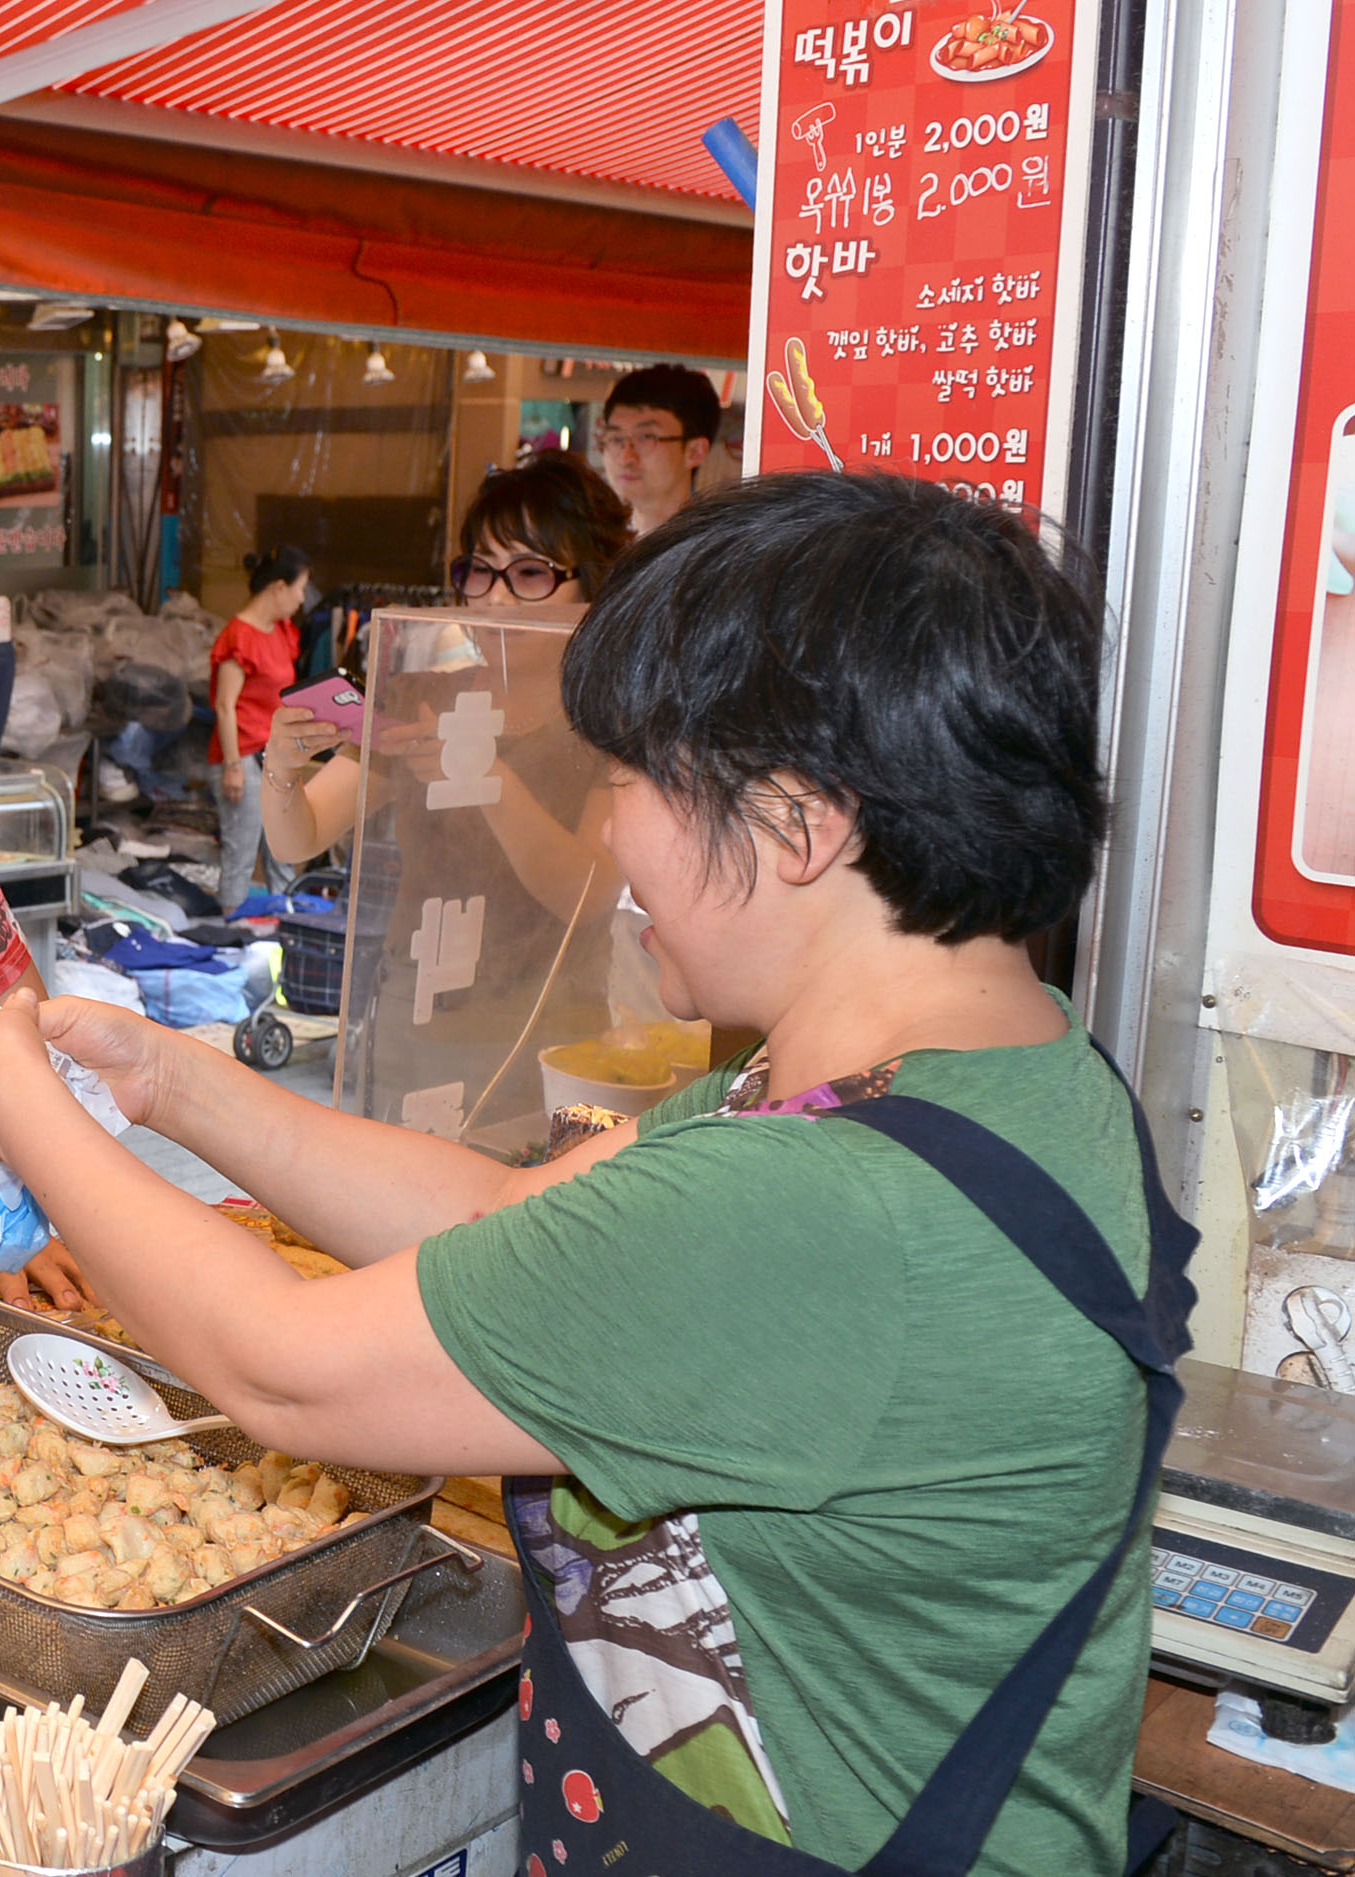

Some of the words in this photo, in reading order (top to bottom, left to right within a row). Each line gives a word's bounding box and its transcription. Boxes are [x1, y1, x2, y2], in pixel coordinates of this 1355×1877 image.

[794, 11, 913, 86] 떡볶이
[855, 124, 907, 158] 1인분
[923, 103, 1050, 154] 2,000원
[785, 239, 877, 300] 핫바
[915, 276, 985, 309] 소세지
[991, 270, 1042, 305] 핫바
[827, 329, 870, 360] 깻잎
[935, 321, 980, 354] 고추
[988, 317, 1038, 351] 핫바
[932, 367, 979, 403] 쌀떡
[985, 364, 1035, 398] 핫바
[859, 431, 893, 458] 1개
[909, 428, 1029, 464] 1,000원
[1175, 1560, 1196, 1571] M2
[1209, 1570, 1231, 1581] M3
